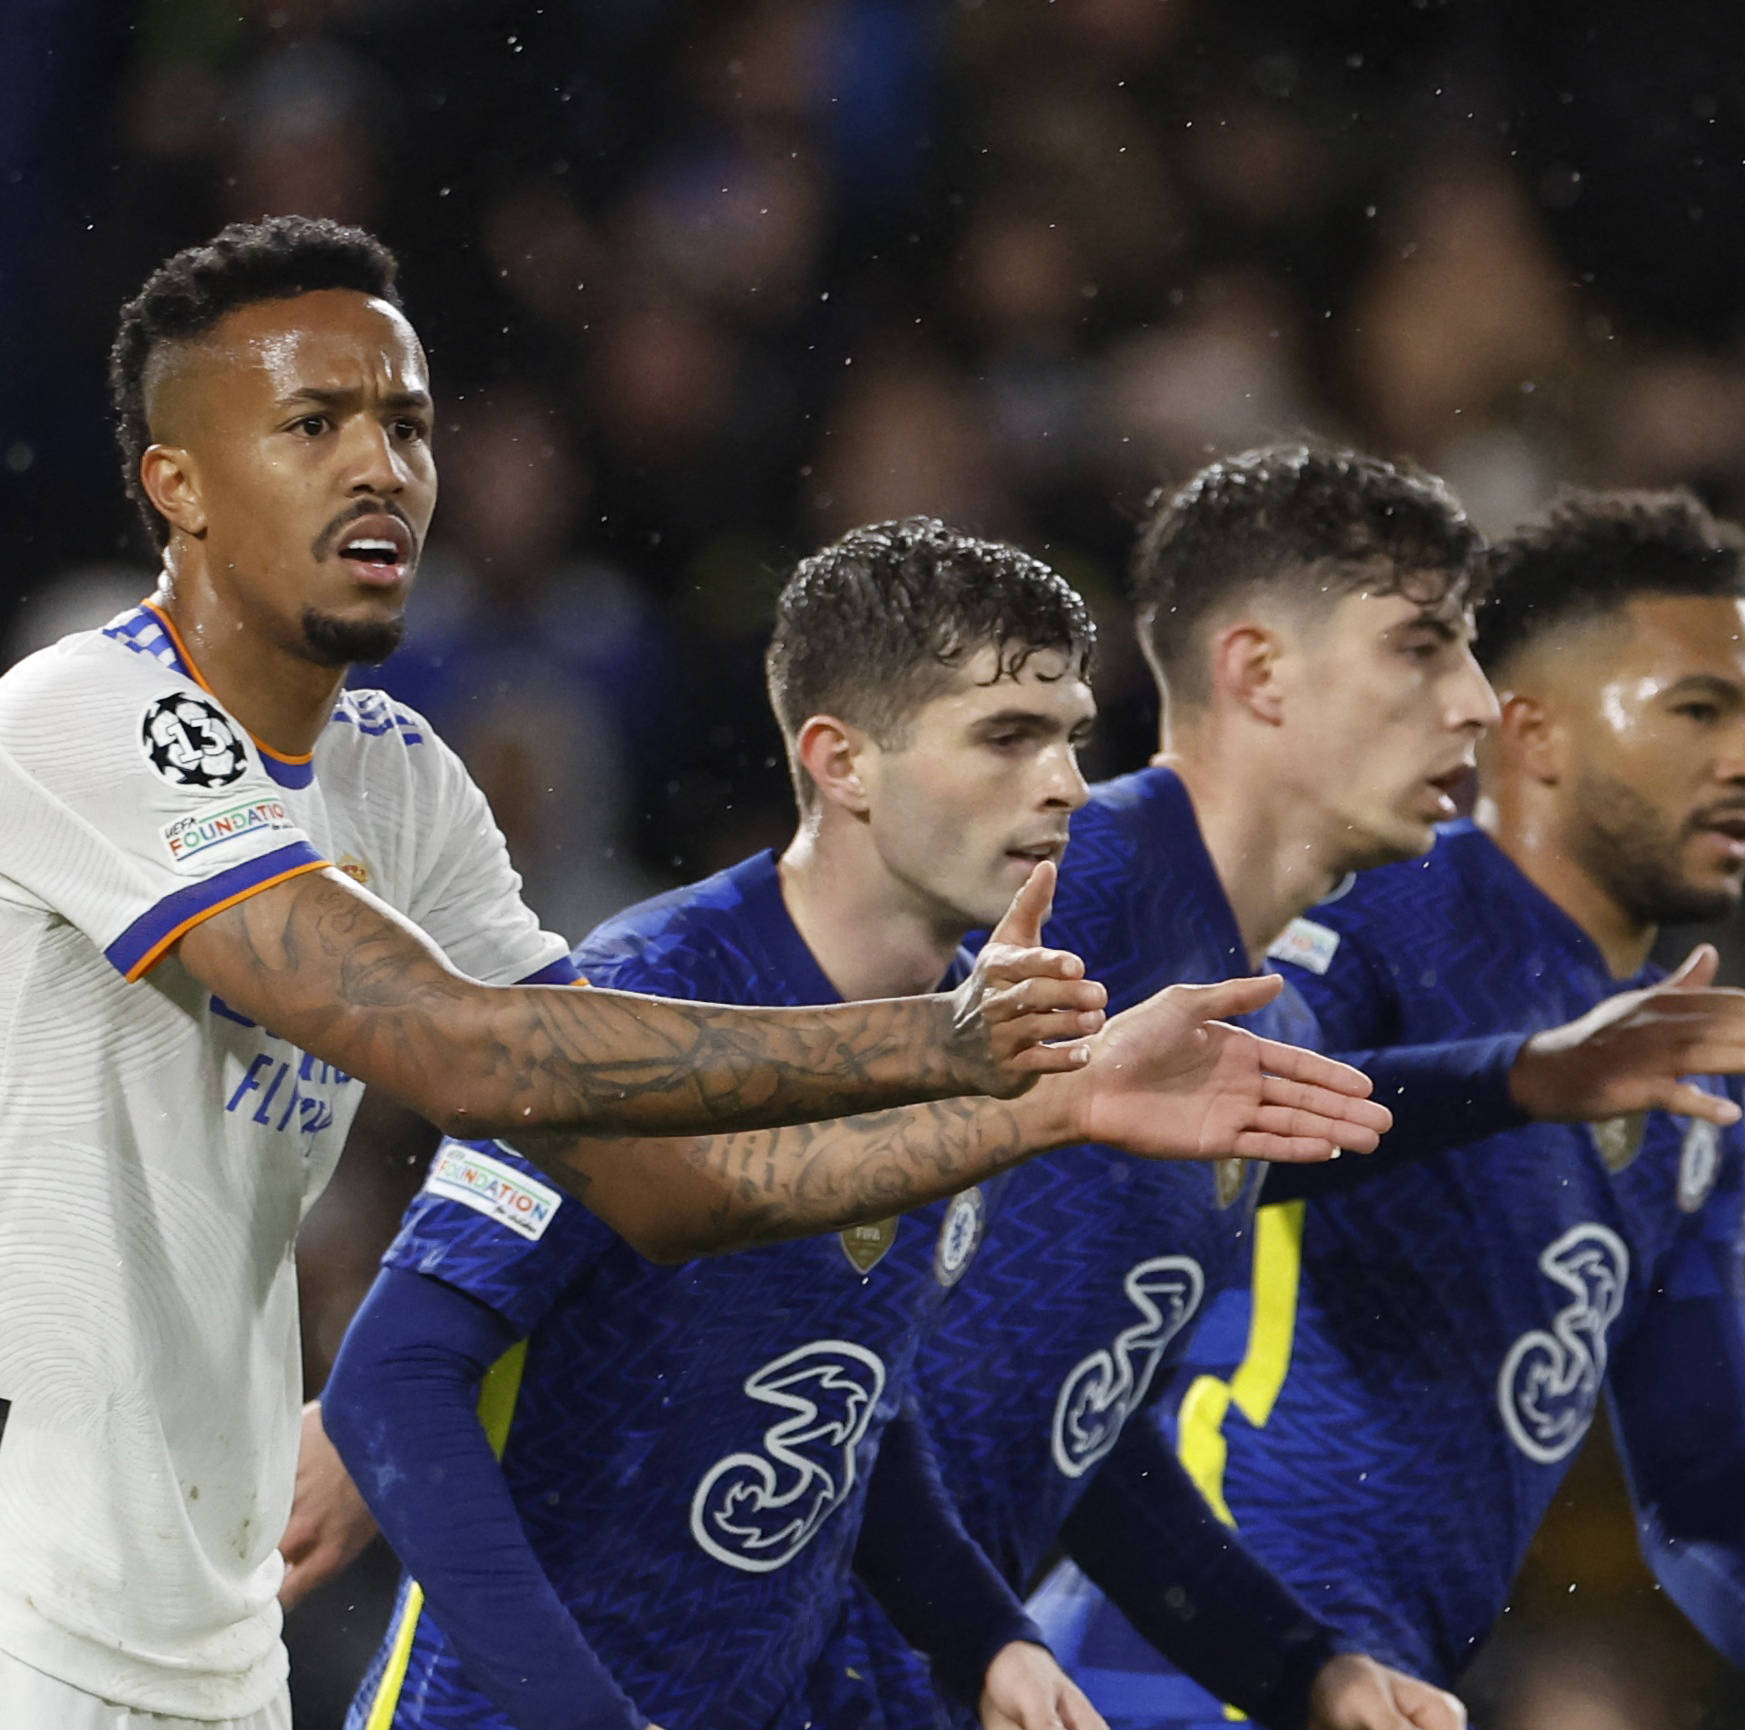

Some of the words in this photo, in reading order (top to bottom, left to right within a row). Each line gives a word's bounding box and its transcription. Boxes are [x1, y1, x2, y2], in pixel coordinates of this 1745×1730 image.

[165, 717, 227, 764] 13
[164, 817, 197, 839] UEFA
[168, 803, 285, 857] FOUNDATIO
[438, 1159, 548, 1222] FOUNDATION
